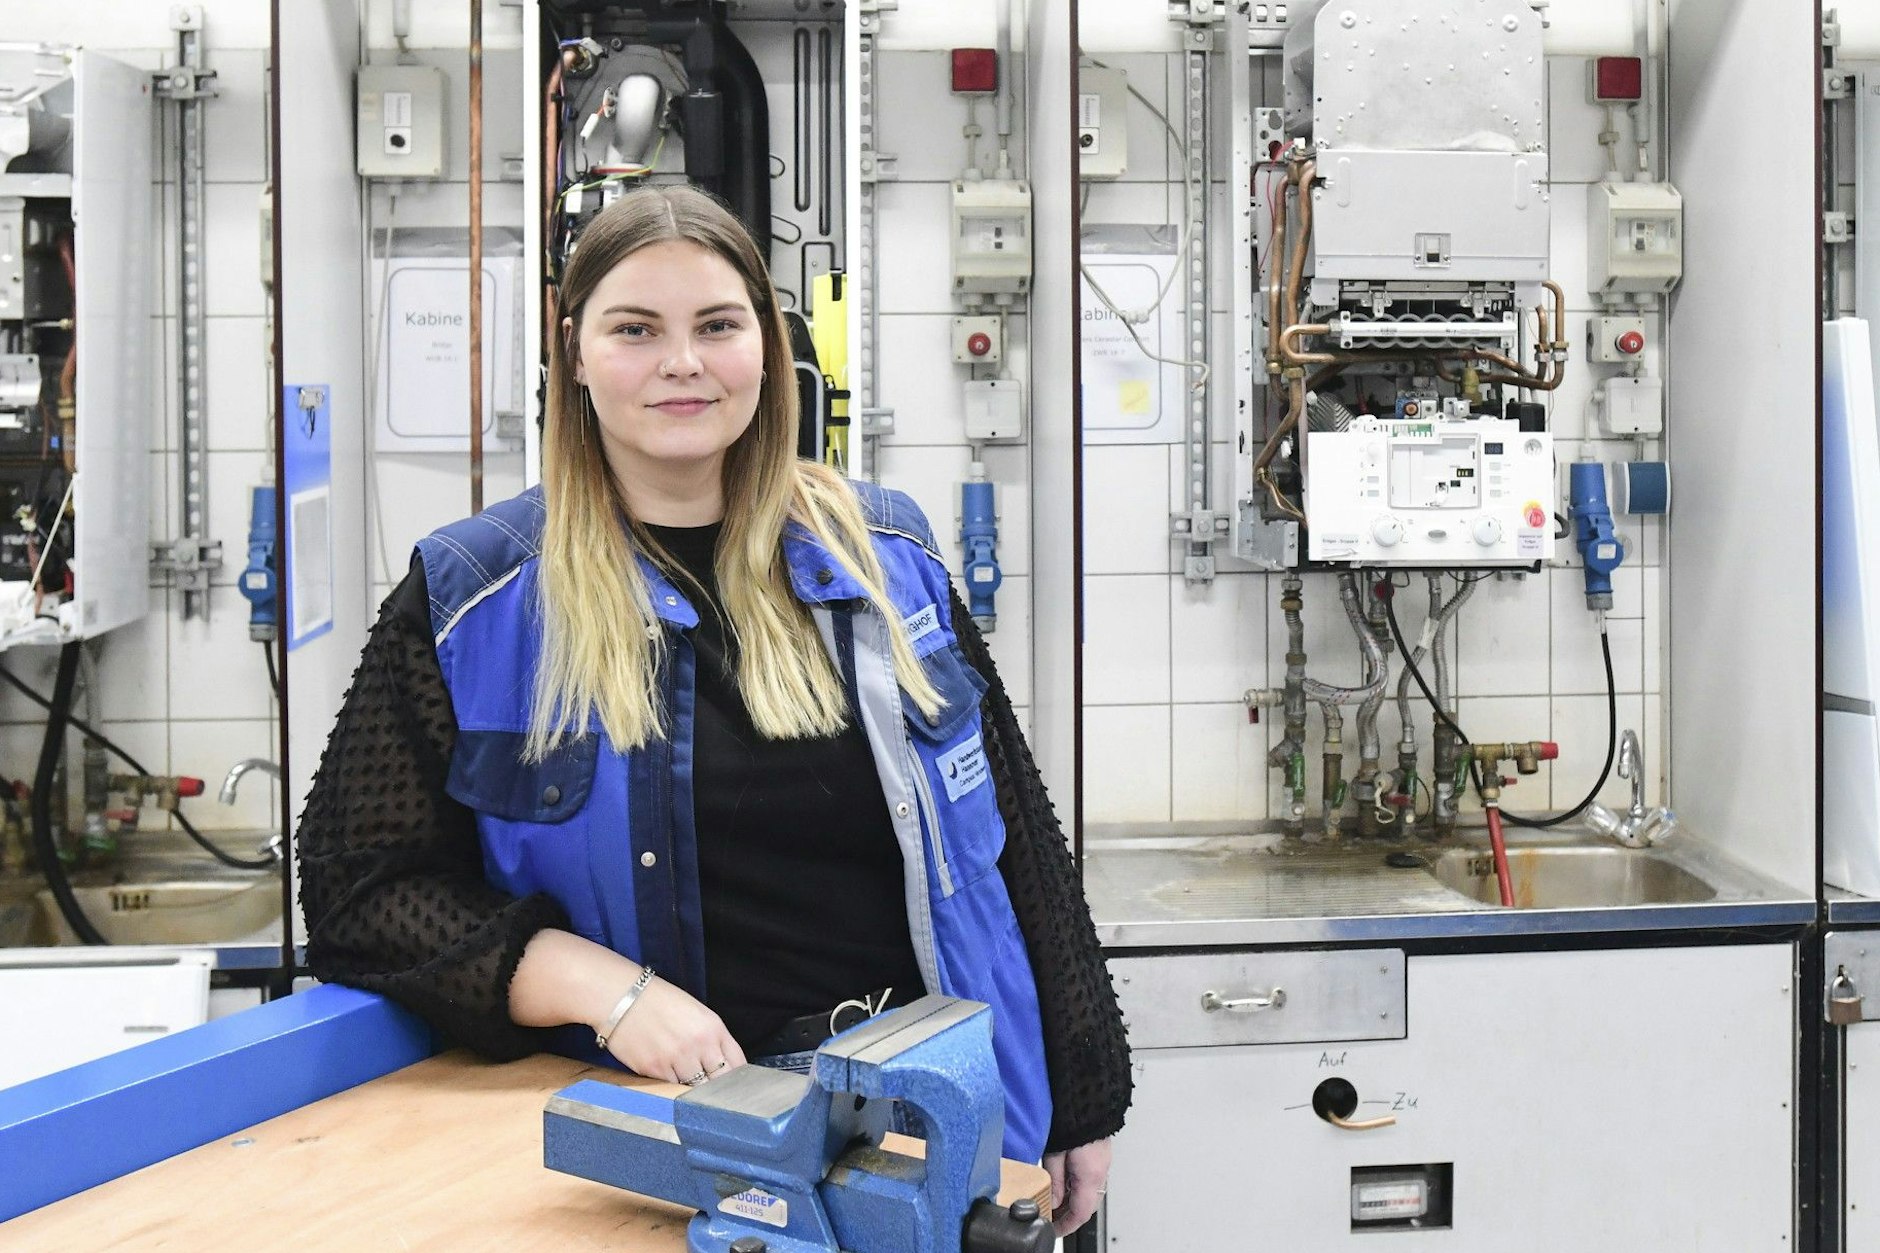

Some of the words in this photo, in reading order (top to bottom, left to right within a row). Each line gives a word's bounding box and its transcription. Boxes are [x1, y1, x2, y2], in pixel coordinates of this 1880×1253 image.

[405, 311, 463, 326] Kabine
[1318, 1051, 1347, 1068] Auf
[1391, 1092, 1418, 1110] Zu
